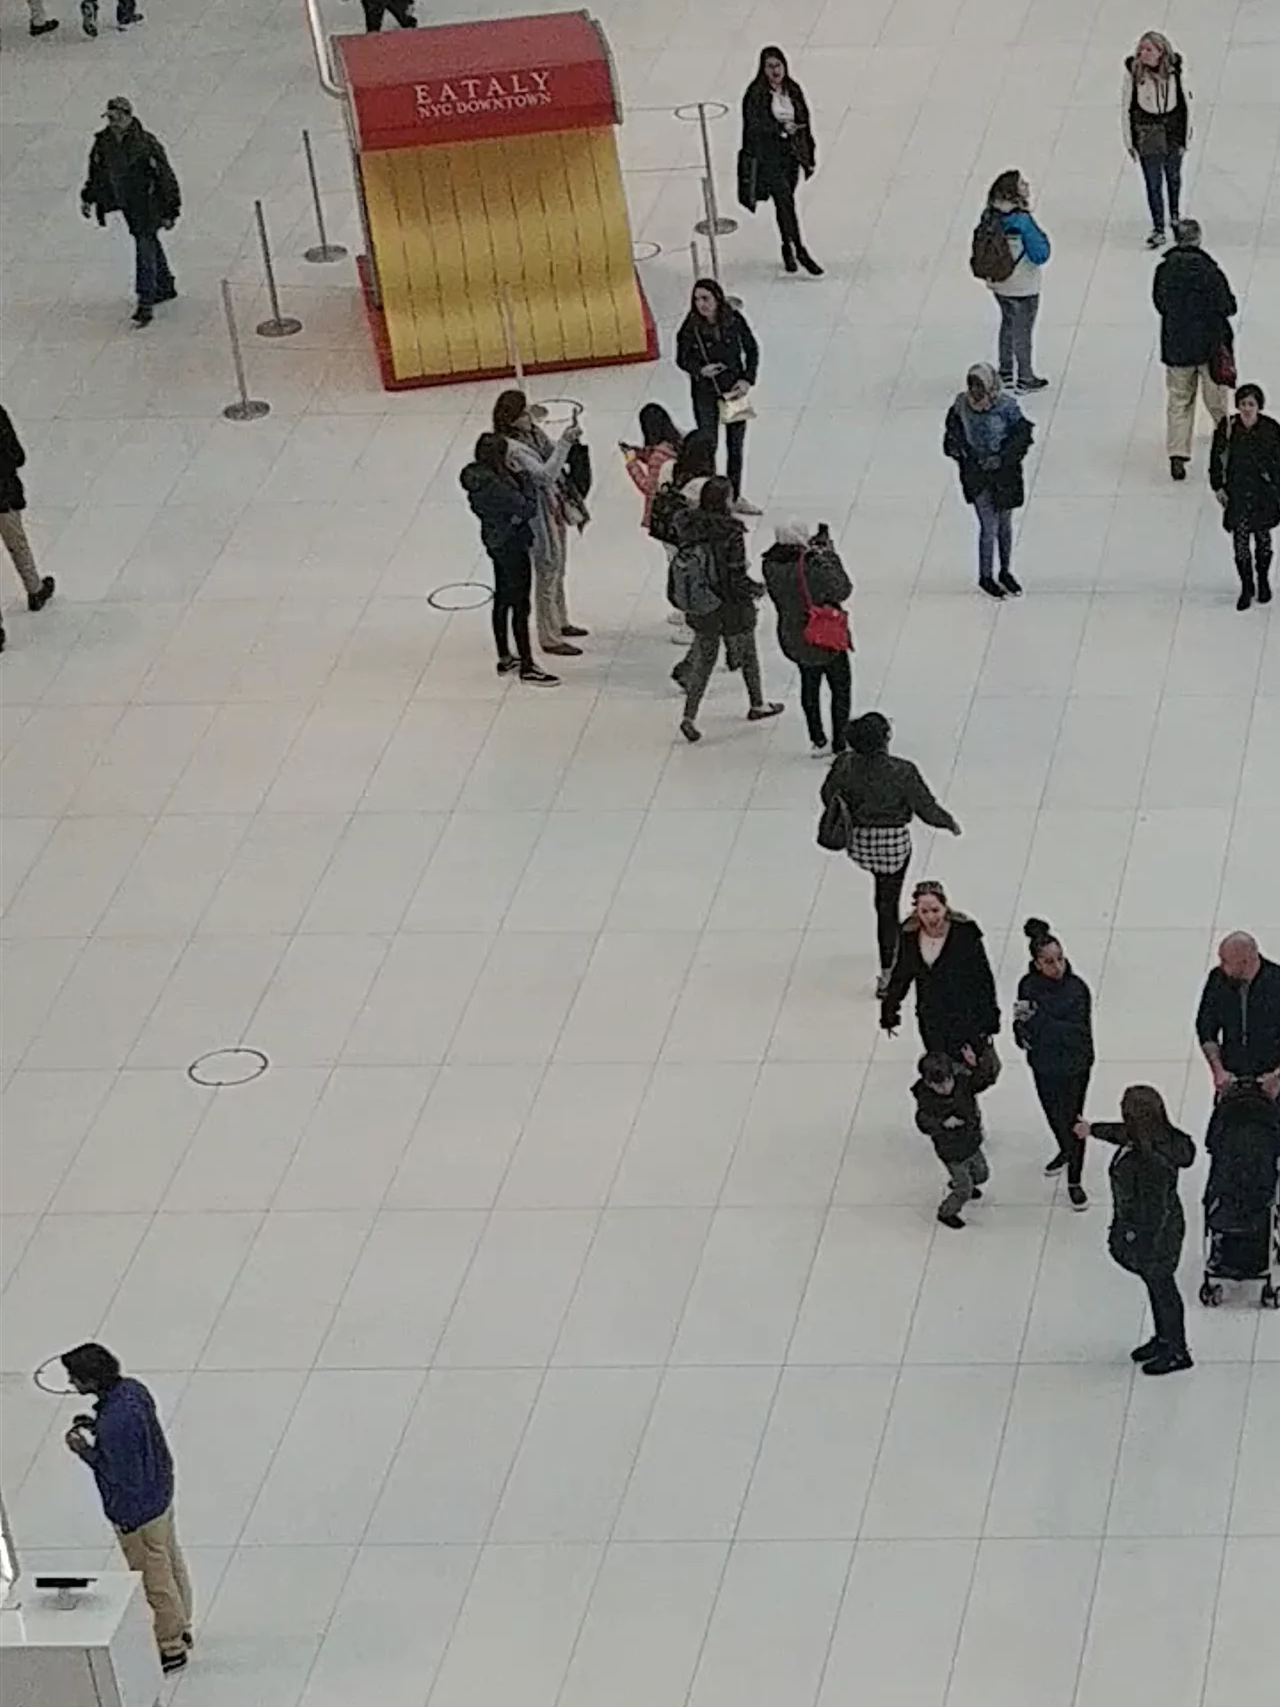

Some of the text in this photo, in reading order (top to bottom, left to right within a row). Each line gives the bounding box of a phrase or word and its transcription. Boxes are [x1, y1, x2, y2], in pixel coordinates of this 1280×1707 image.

[414, 71, 550, 104] EATALY
[417, 92, 552, 118] NYC DOWNTOWN
